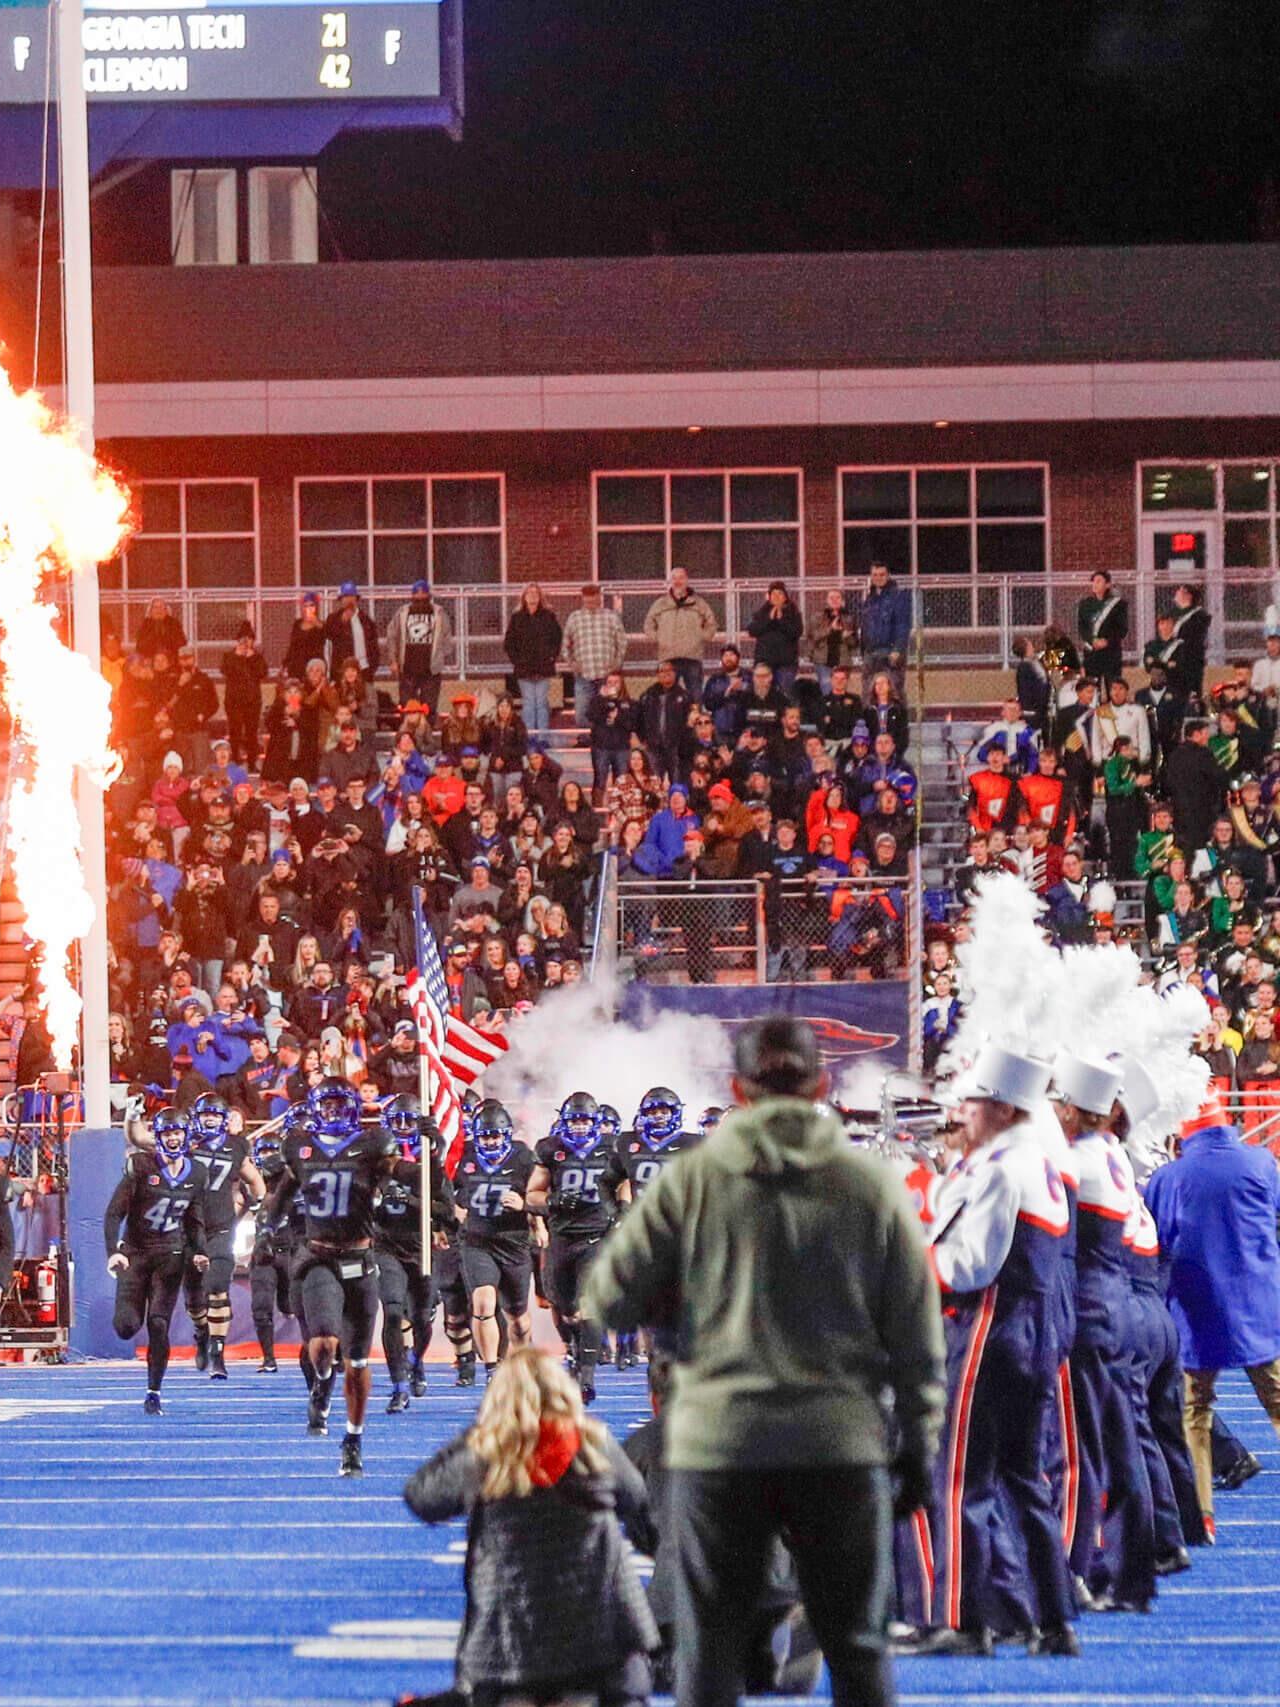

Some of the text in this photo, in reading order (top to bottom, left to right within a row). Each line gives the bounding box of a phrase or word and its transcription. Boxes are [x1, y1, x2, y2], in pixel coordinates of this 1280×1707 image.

[82, 12, 347, 51] GEORGIA TECH 21
[384, 29, 402, 65] F
[13, 36, 31, 72] F
[82, 53, 352, 92] CLEMSON 42
[309, 1170, 353, 1217] 31
[470, 1182, 513, 1218] 47
